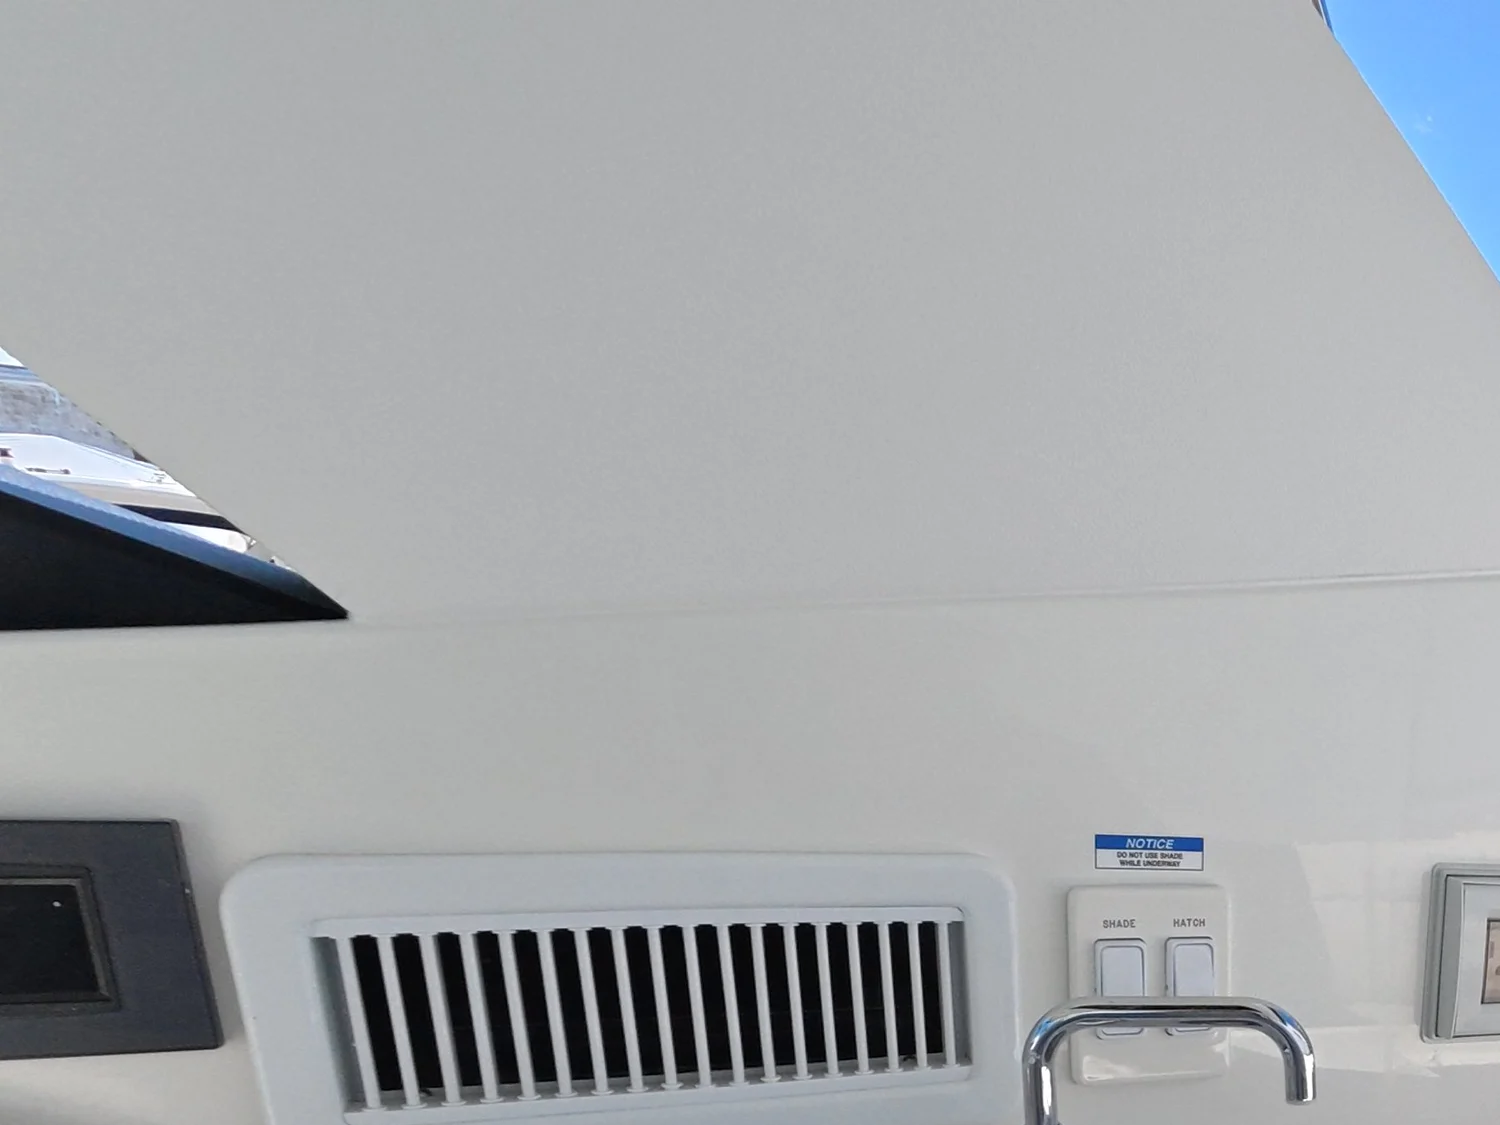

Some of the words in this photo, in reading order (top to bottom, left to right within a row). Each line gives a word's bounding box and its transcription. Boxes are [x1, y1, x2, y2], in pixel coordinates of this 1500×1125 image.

[1125, 838, 1175, 850] NOTICE
[1116, 851, 1128, 859] DO
[1128, 851, 1144, 859] NOT
[1160, 852, 1183, 860] SHADE
[1119, 859, 1142, 867] WHILE
[1142, 860, 1181, 868] UNDERWAY
[1102, 919, 1136, 929] SHADE
[1173, 918, 1206, 928] HATCH
